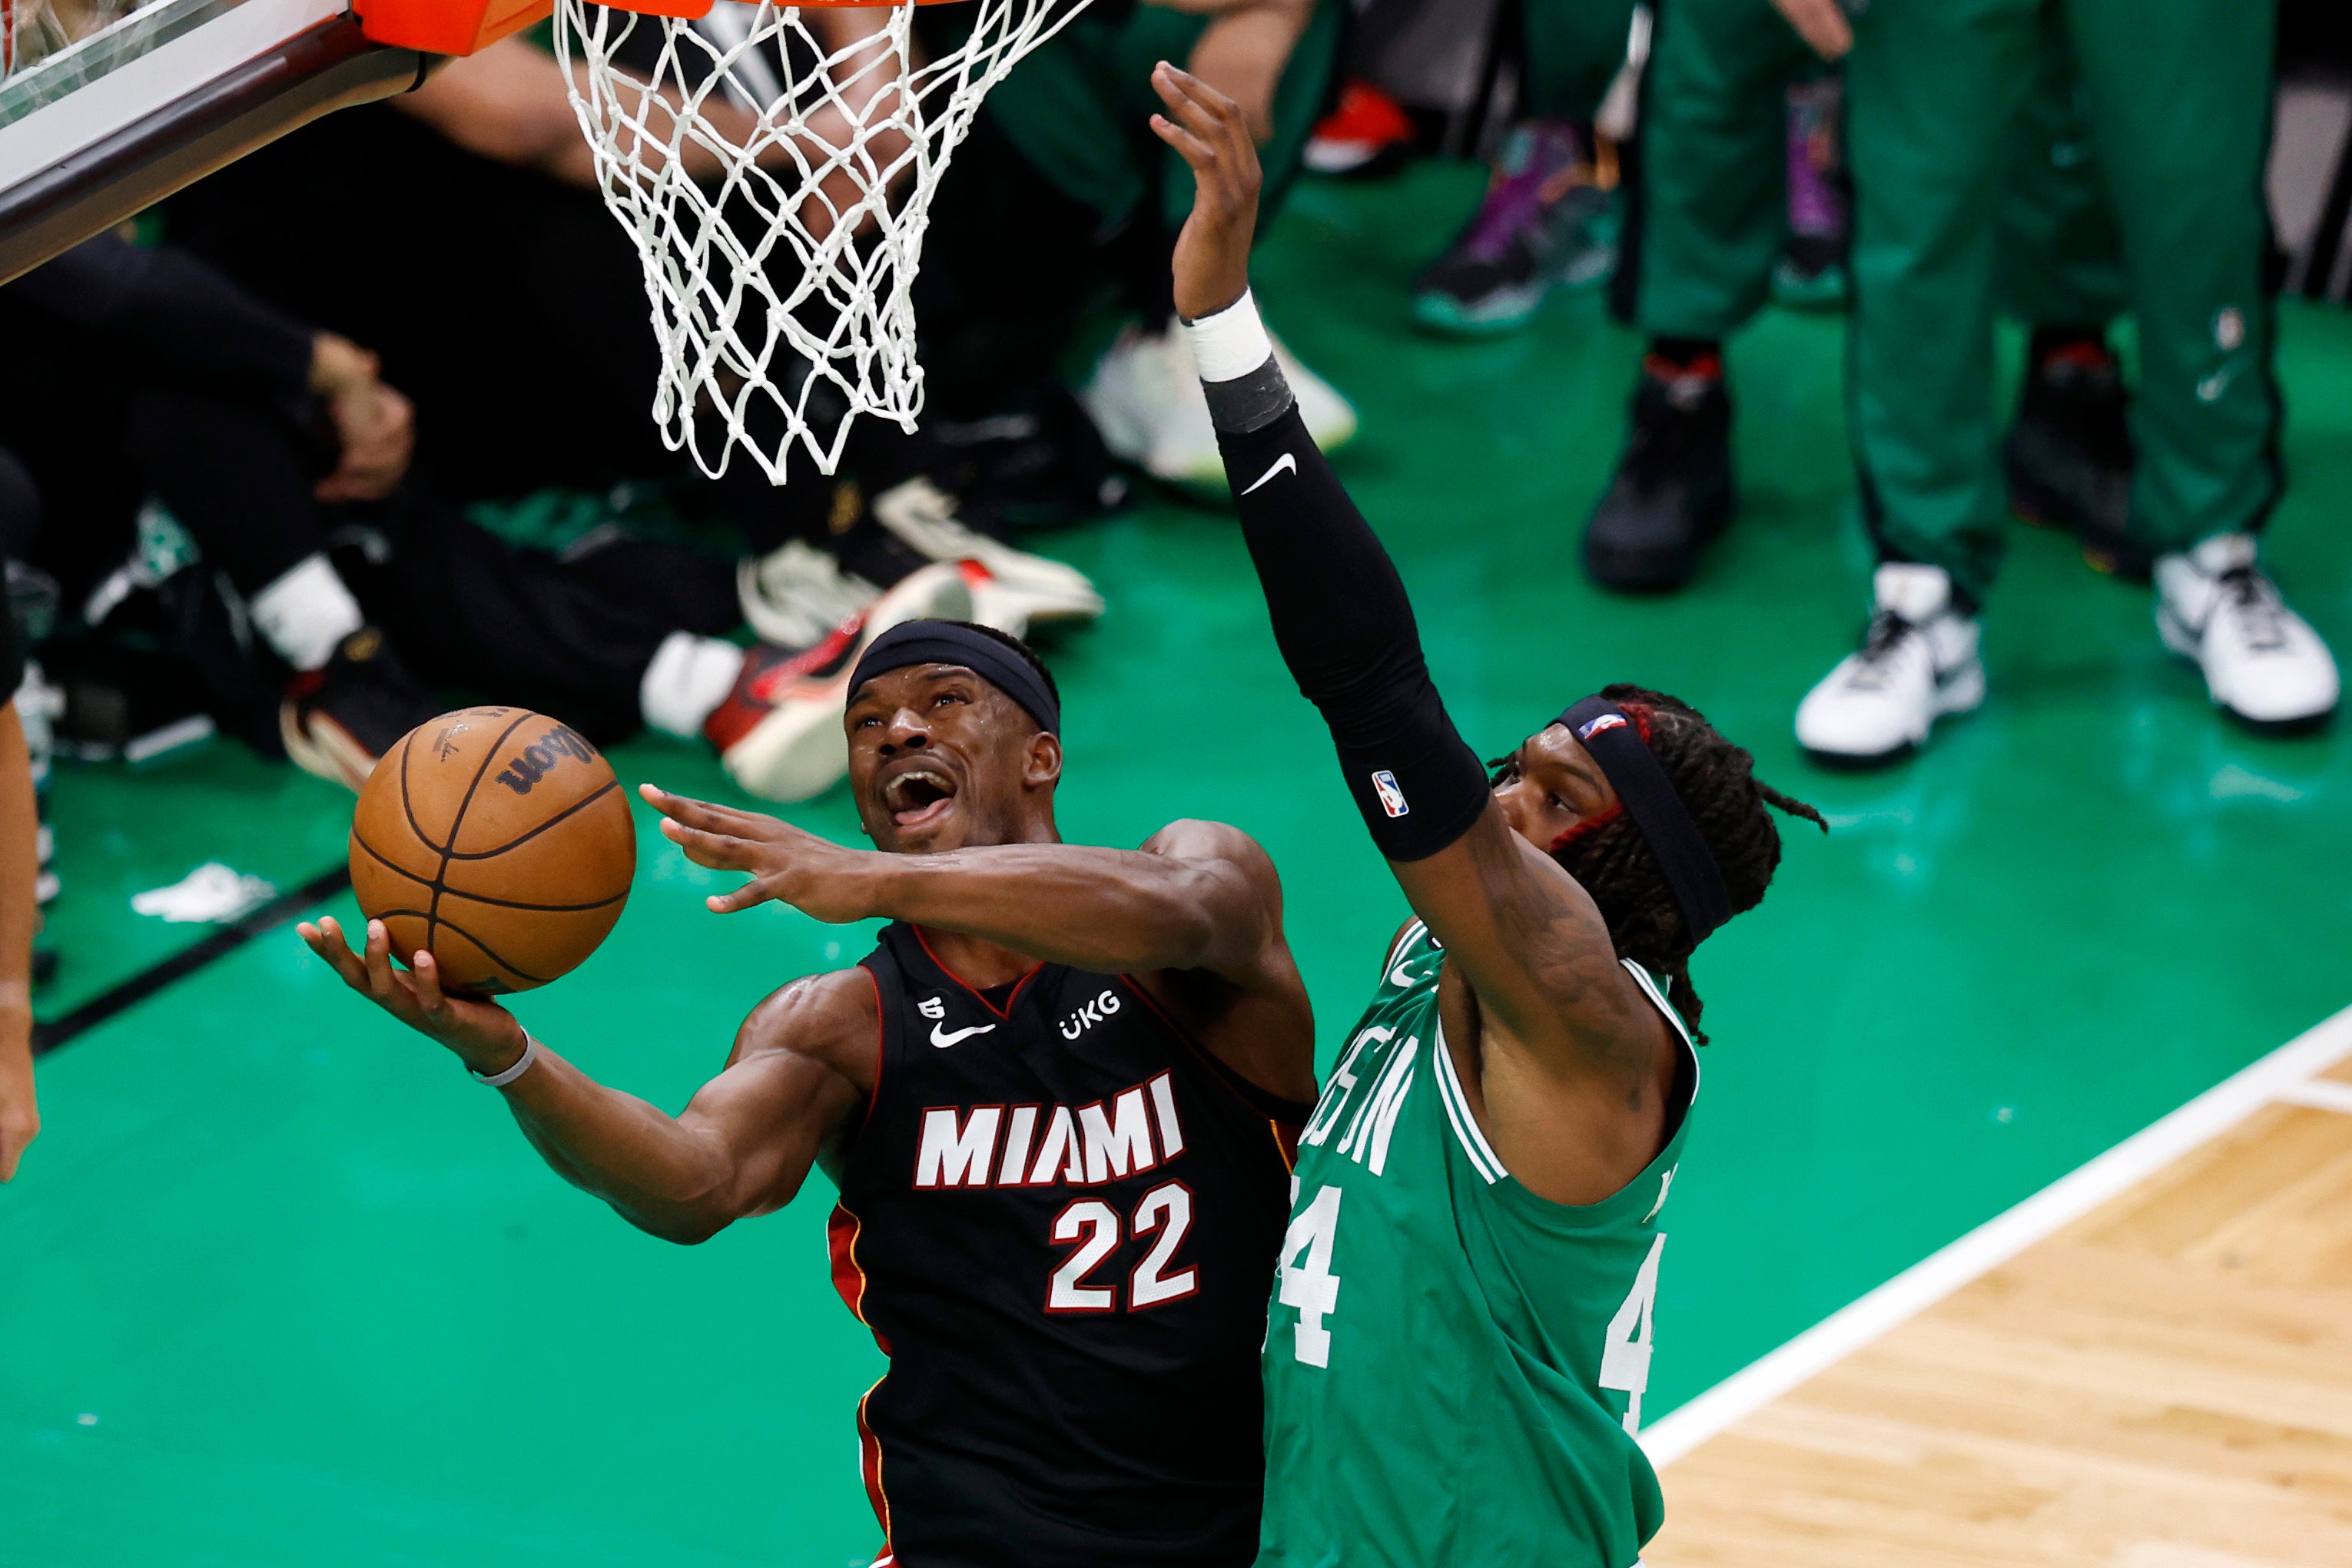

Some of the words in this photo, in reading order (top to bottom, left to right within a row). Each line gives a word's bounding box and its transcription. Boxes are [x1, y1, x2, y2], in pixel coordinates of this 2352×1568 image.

[912, 1067, 1187, 1190] MIAMI
[1044, 1178, 1199, 1313] 22
[1262, 1175, 1342, 1369] 4
